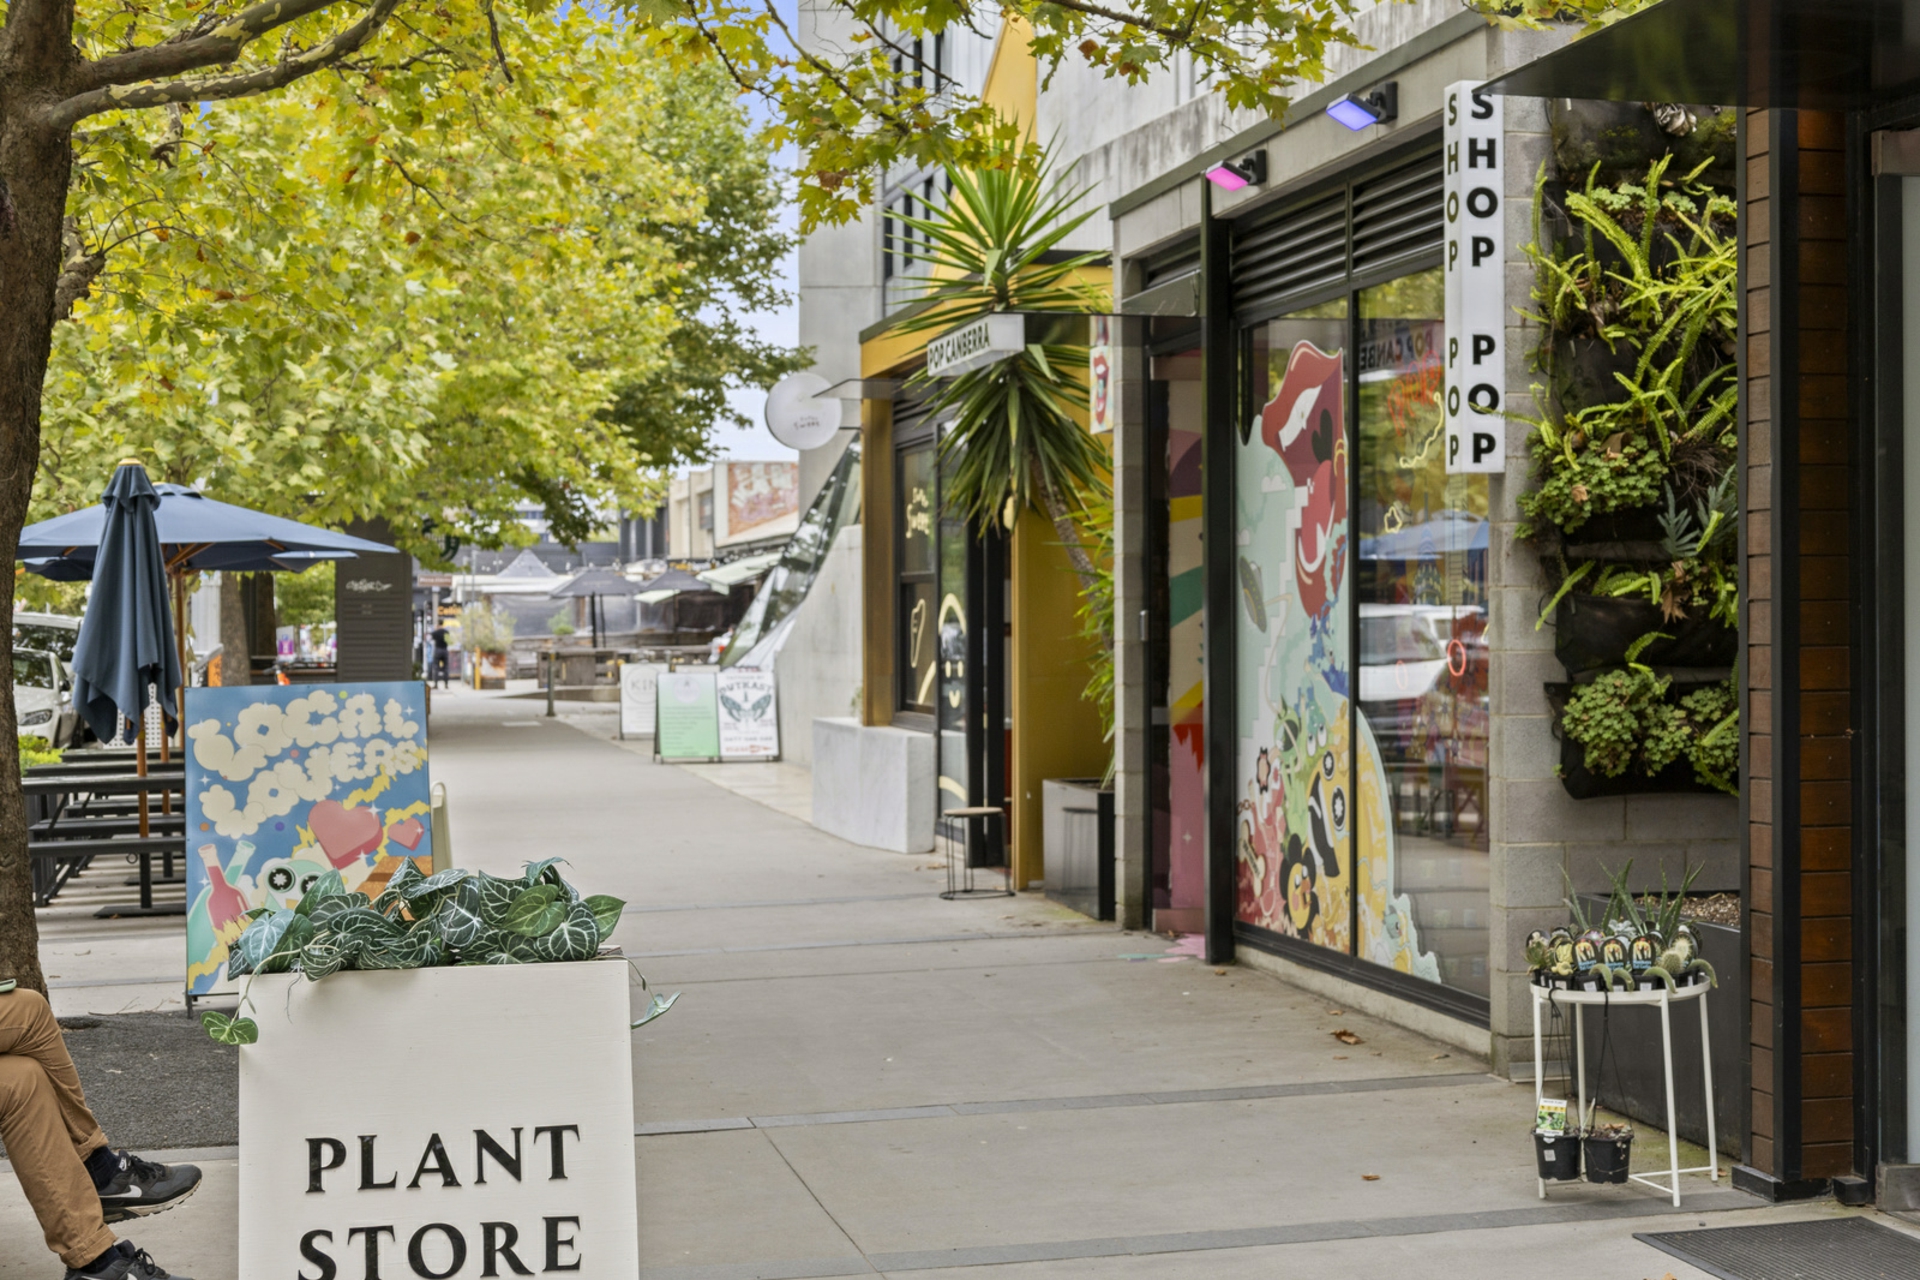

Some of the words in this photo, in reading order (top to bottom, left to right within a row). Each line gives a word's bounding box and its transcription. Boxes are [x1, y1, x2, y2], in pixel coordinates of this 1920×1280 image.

[1446, 92, 1460, 271] SHOP
[1466, 90, 1499, 267] SHOP
[928, 343, 944, 372] POP
[946, 322, 990, 364] CANBERRA
[1446, 336, 1461, 466] POP
[1467, 334, 1501, 464] POP
[188, 690, 419, 781] LOCAL
[199, 738, 419, 839] LOVERS
[305, 1124, 581, 1194] PLANT
[298, 1216, 582, 1280] STORE
